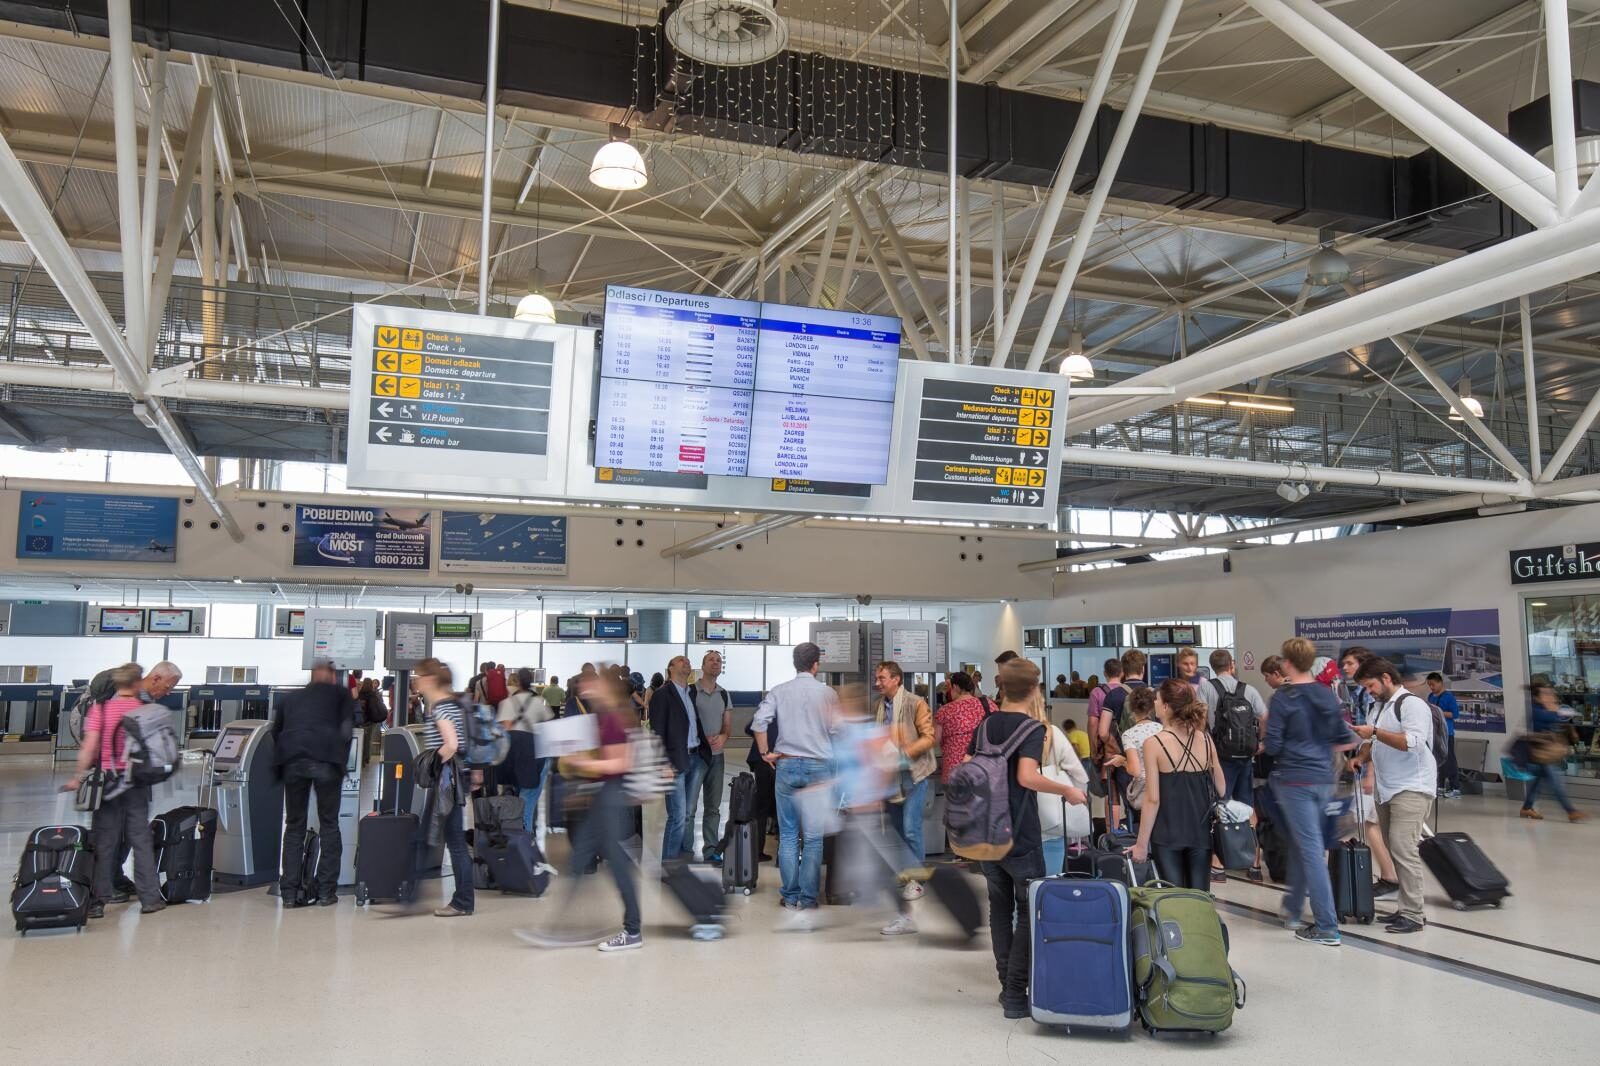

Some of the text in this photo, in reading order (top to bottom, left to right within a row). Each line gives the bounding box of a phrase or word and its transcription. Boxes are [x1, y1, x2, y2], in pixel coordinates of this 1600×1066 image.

[607, 289, 710, 308] Odlasci / Departures
[426, 333, 449, 342] Check
[793, 334, 814, 342] ZAGREB
[426, 342, 449, 352] Check
[458, 345, 466, 353] in
[453, 358, 481, 369] odlazak
[424, 365, 497, 380] Domestic departure
[423, 381, 442, 390] Izlazi
[993, 386, 1011, 394] Check
[423, 389, 445, 399] Gates
[990, 394, 1007, 402] Check
[785, 406, 809, 414] HELSINKI
[997, 407, 1018, 415] odlazak
[438, 414, 465, 425] lounge
[723, 417, 745, 425] Saturday
[956, 412, 1018, 424] International departure
[987, 426, 1002, 434] Izlazi
[420, 436, 461, 447] Coffee bar
[984, 434, 1000, 442] Gates
[970, 453, 1013, 464] Business lounge
[944, 465, 991, 475] Carinska provjera
[616, 474, 645, 483] Departure
[944, 473, 994, 482] Customs validation
[788, 485, 814, 493] Departure
[302, 508, 374, 522] POBIJEDIMO
[329, 531, 356, 540] ZRAČNI
[375, 532, 425, 541] Grad Dubrovnik
[329, 540, 365, 551] MOST
[375, 555, 424, 566] 0800 2013
[1300, 621, 1306, 629] If
[1318, 621, 1331, 629] had
[1331, 620, 1346, 628] nice
[1346, 618, 1372, 628] holiday
[1372, 618, 1379, 626] in
[1380, 617, 1409, 626] Croatia,
[90, 625, 96, 633] 7
[194, 625, 200, 634] 8
[279, 626, 285, 634] 9
[1316, 632, 1329, 640] you
[1329, 630, 1356, 639] thought
[1356, 628, 1378, 637] about
[1378, 627, 1404, 637] second
[1405, 627, 1428, 635] home
[1428, 625, 1447, 634] here
[548, 631, 556, 639] 12
[630, 631, 638, 639] 13
[696, 633, 704, 641] 14
